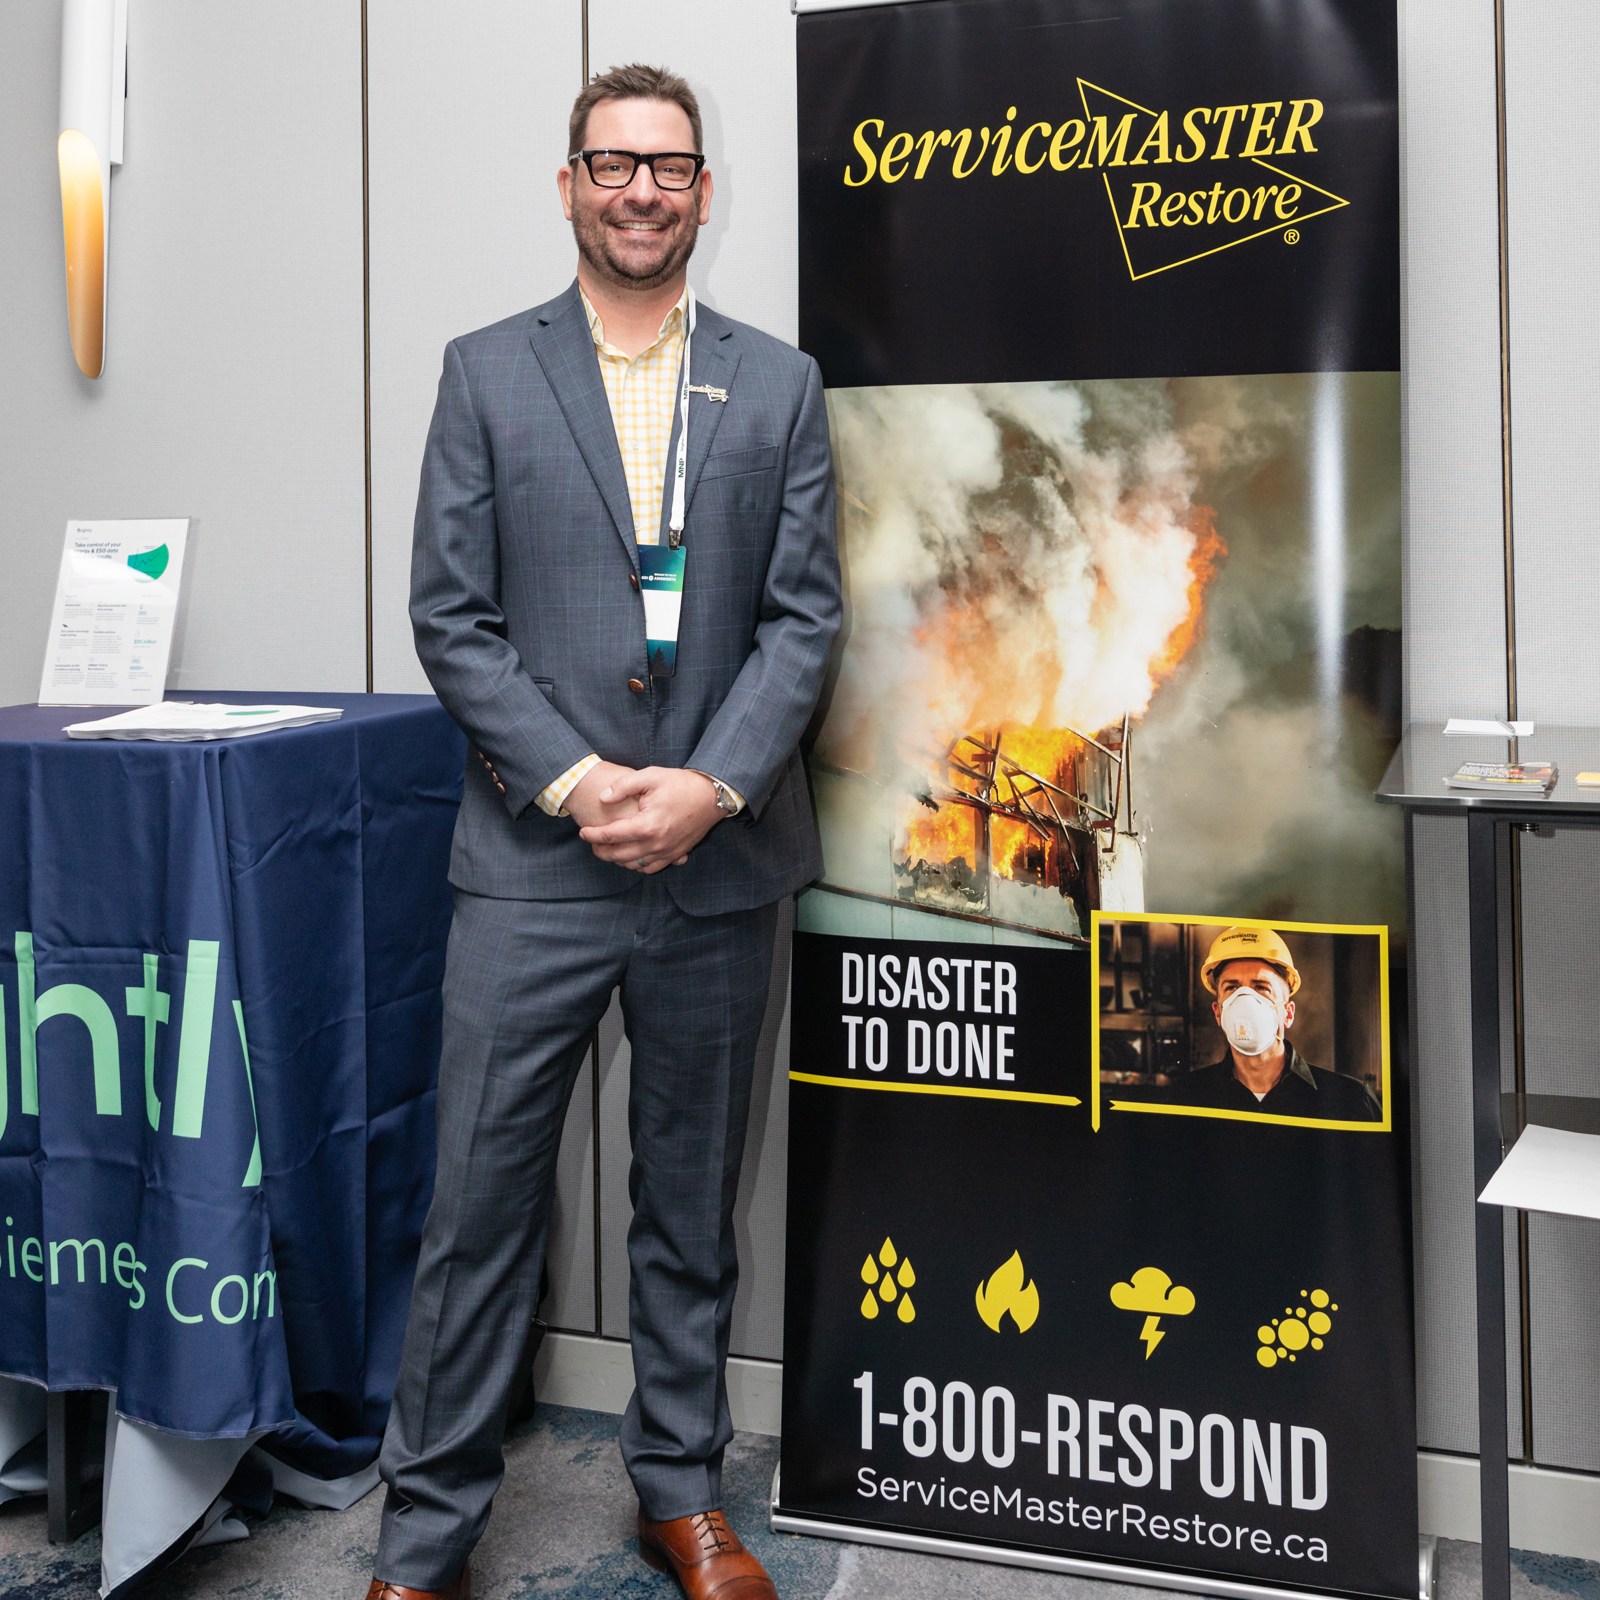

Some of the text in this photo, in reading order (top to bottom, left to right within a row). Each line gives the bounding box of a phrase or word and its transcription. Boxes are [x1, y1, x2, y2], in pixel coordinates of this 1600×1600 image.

[843, 99, 1324, 187] ServiceMASTER
[1123, 181, 1302, 228] Restore
[842, 952, 1017, 1015] DISASTER
[842, 1014, 1016, 1081] TO DONE
[853, 1371, 1329, 1512] 1-800-RESPOND
[856, 1467, 1329, 1562] ServiceMasterRestore.ca
